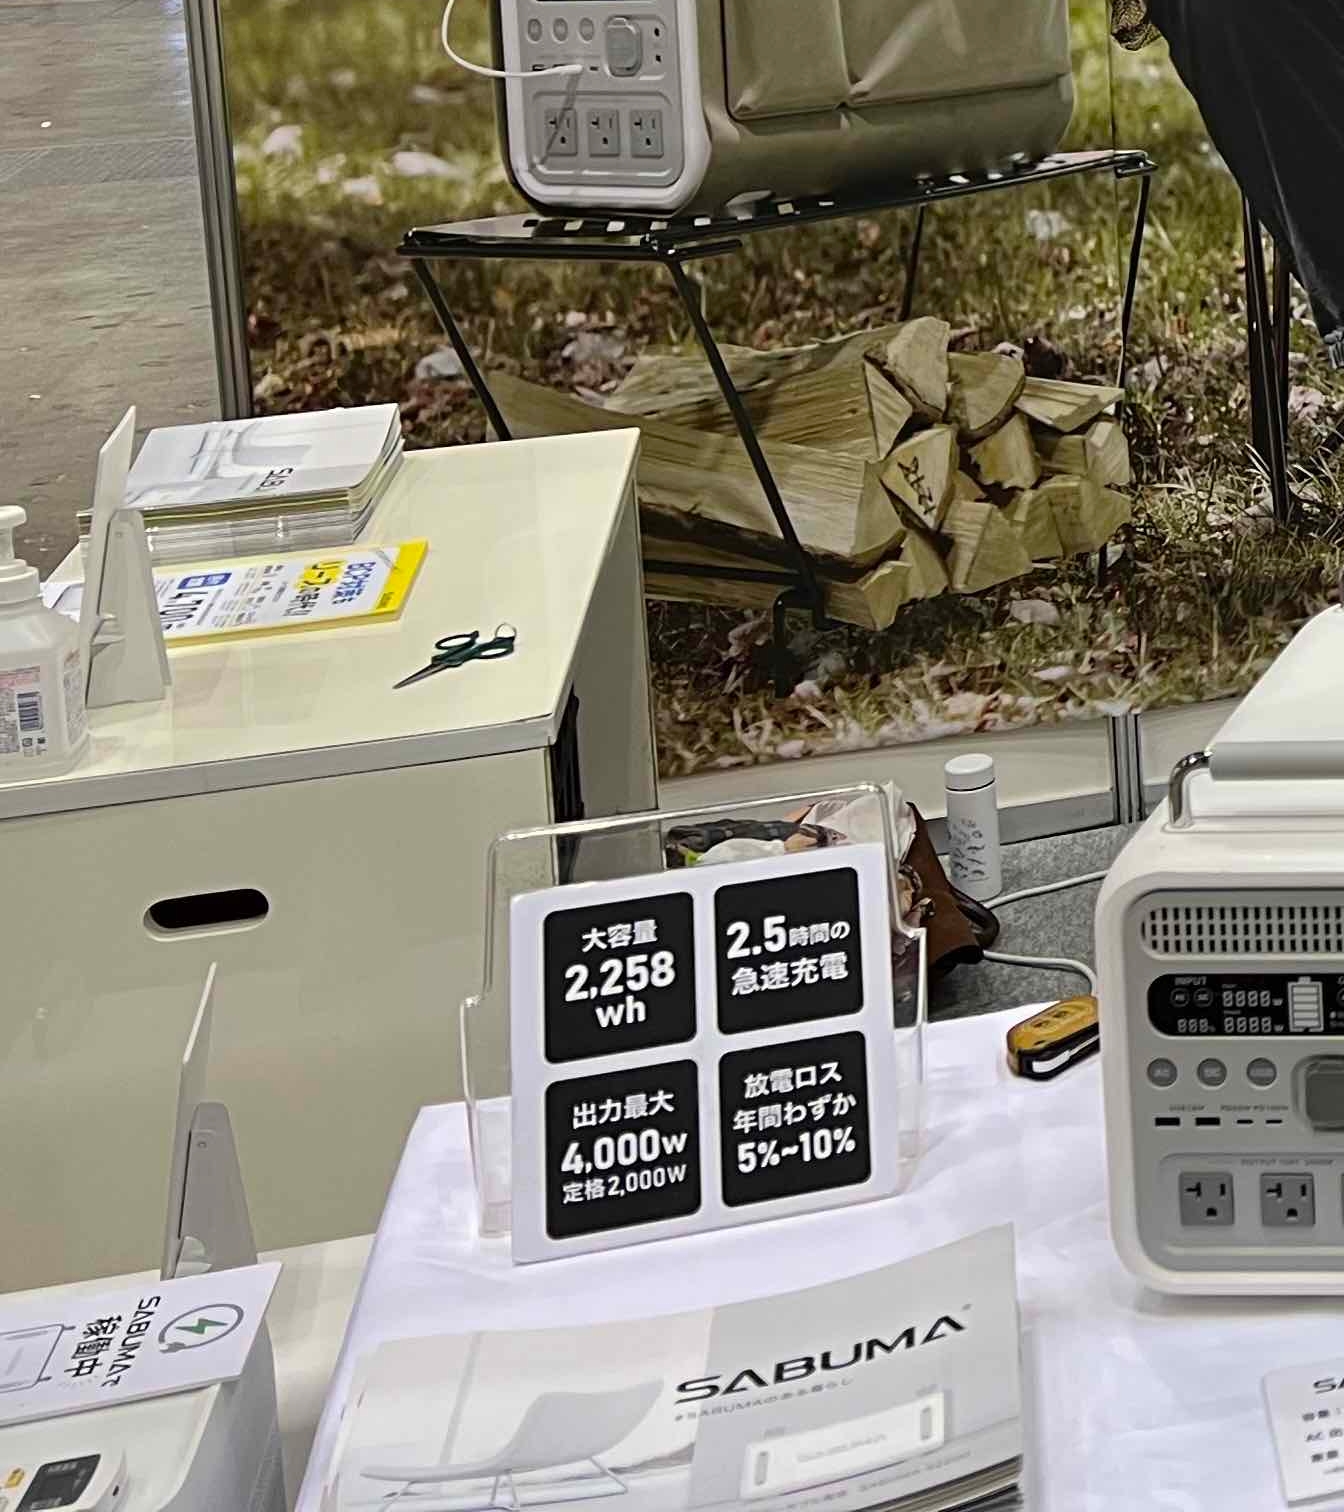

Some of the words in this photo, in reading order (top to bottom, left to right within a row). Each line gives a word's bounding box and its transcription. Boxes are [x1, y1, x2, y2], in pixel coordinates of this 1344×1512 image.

[582, 919, 658, 952] 大容量
[725, 915, 851, 960] 2.5時間の
[564, 950, 676, 1002] 2,258
[731, 951, 849, 996] 急速充電
[595, 995, 646, 1029] wh
[744, 1060, 842, 1099] 放電ロス
[572, 1090, 674, 1130] 出力最大
[732, 1091, 857, 1135] 年間わずか
[674, 1315, 965, 1405] SABUMA
